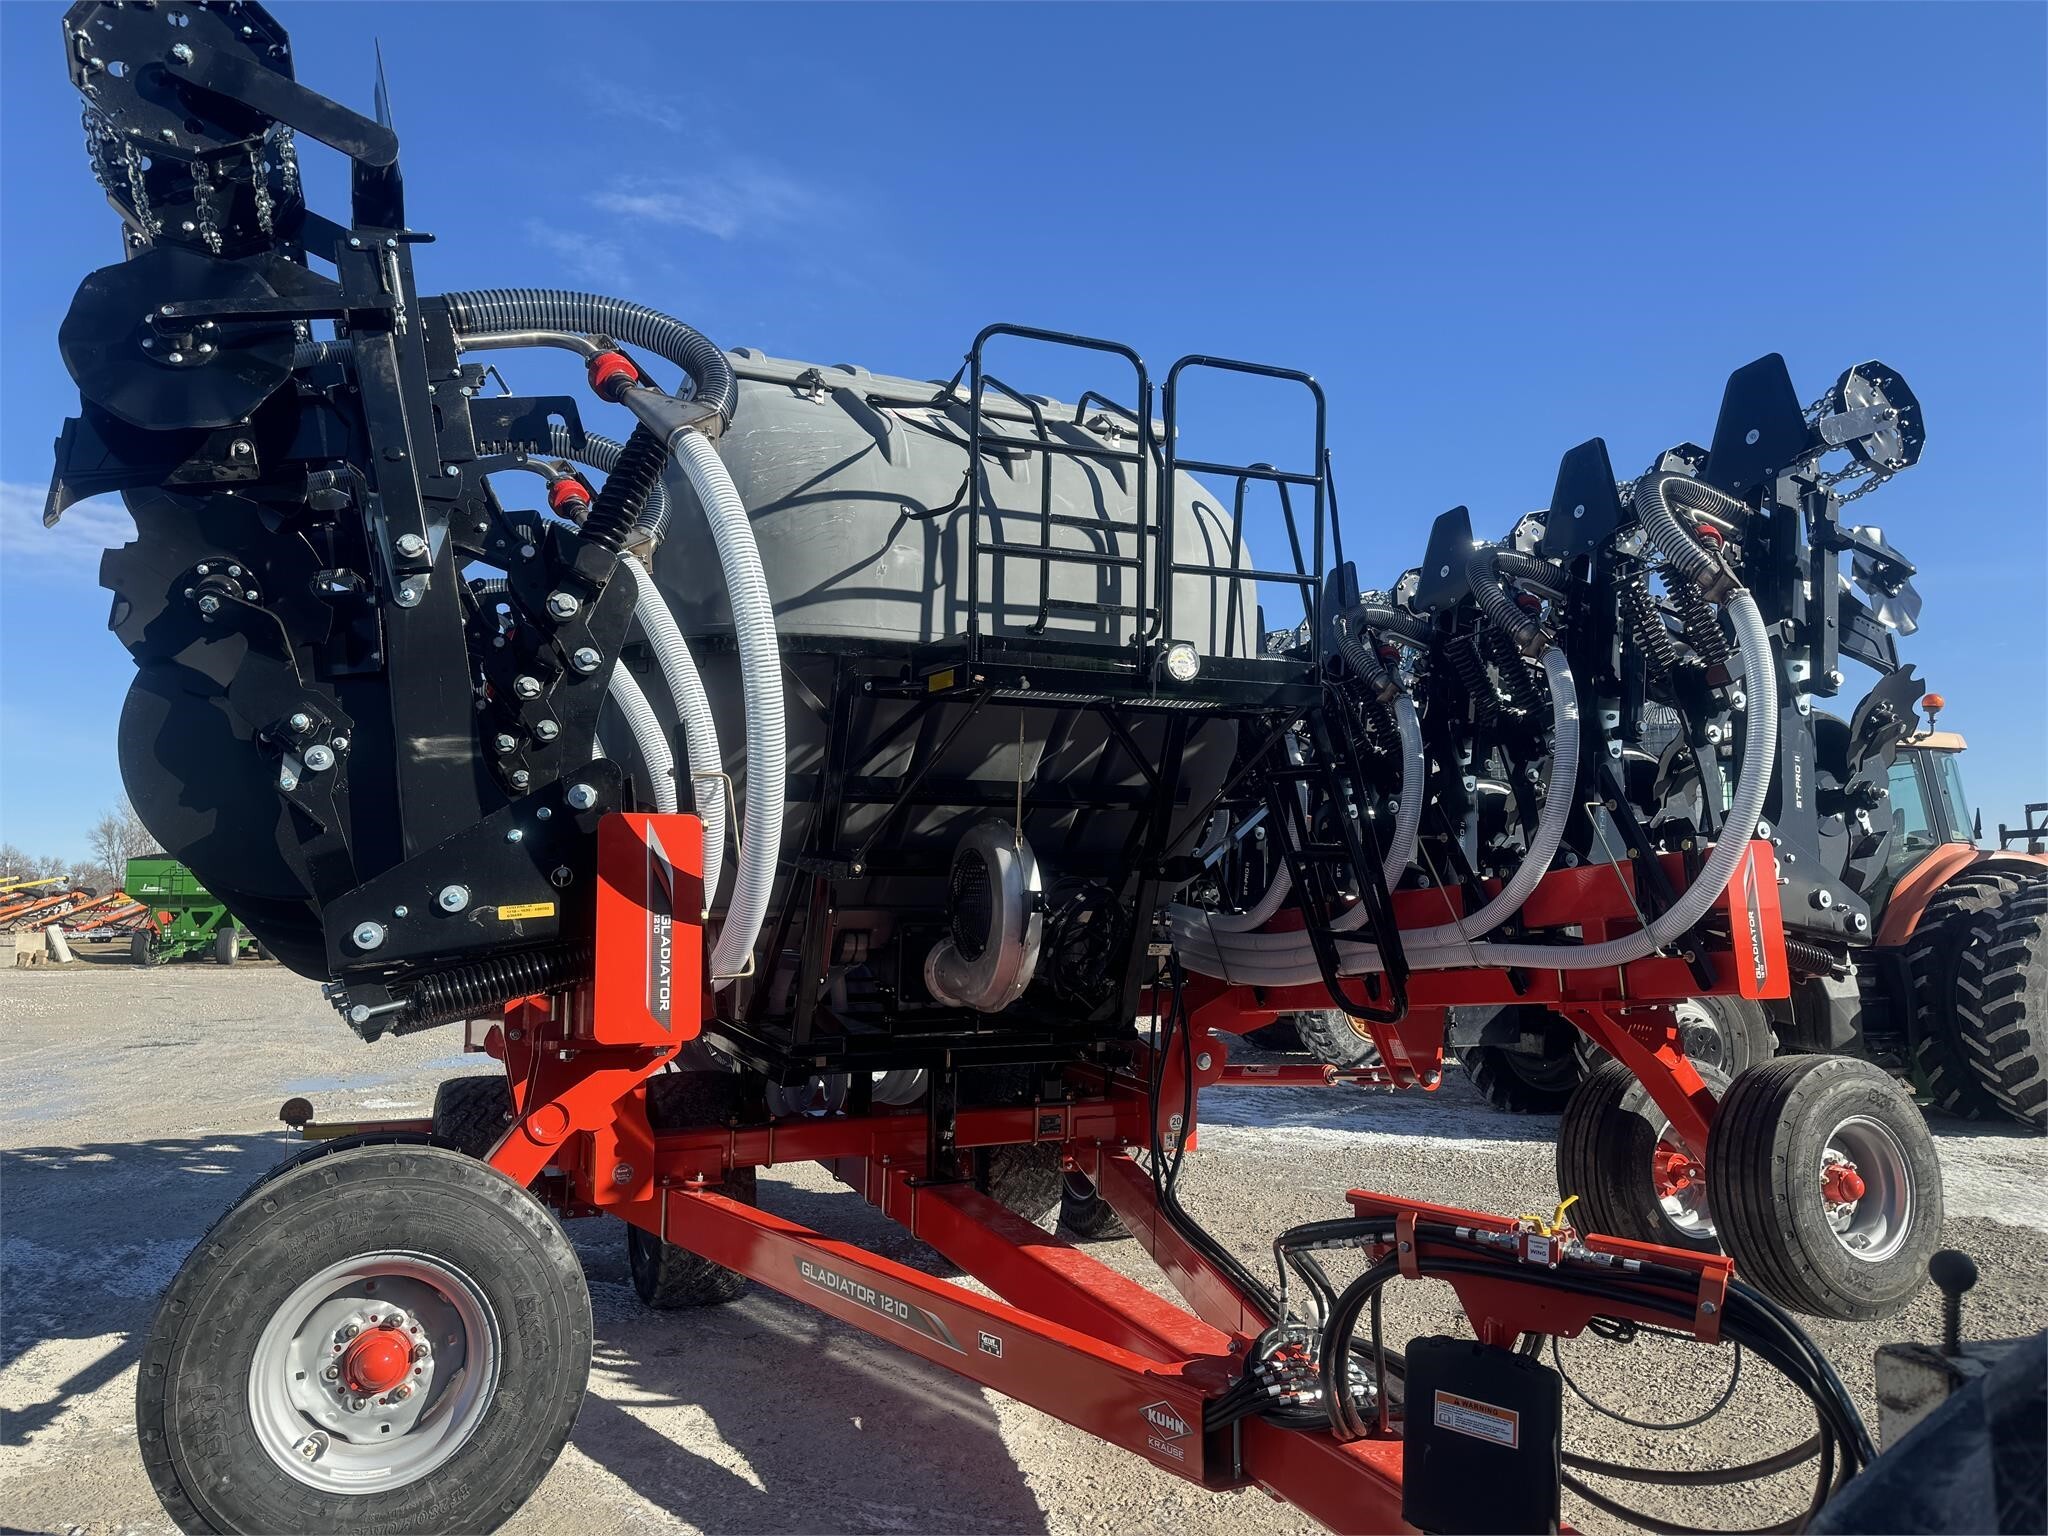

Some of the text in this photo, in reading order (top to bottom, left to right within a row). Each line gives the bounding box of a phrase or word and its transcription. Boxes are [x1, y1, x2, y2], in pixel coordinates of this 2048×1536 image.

[1794, 765, 1802, 809] ST-PRO
[653, 914, 661, 934] 1210
[1748, 911, 1762, 979] GLADIATOR
[660, 914, 672, 1012] GLADIATOR
[1171, 1117, 1182, 1126] 20
[801, 1261, 908, 1320] GLADIATOR 1210
[1148, 1408, 1184, 1435] KUHN
[1462, 1400, 1499, 1416] WARNING
[1148, 1437, 1184, 1459] KRAUSE
